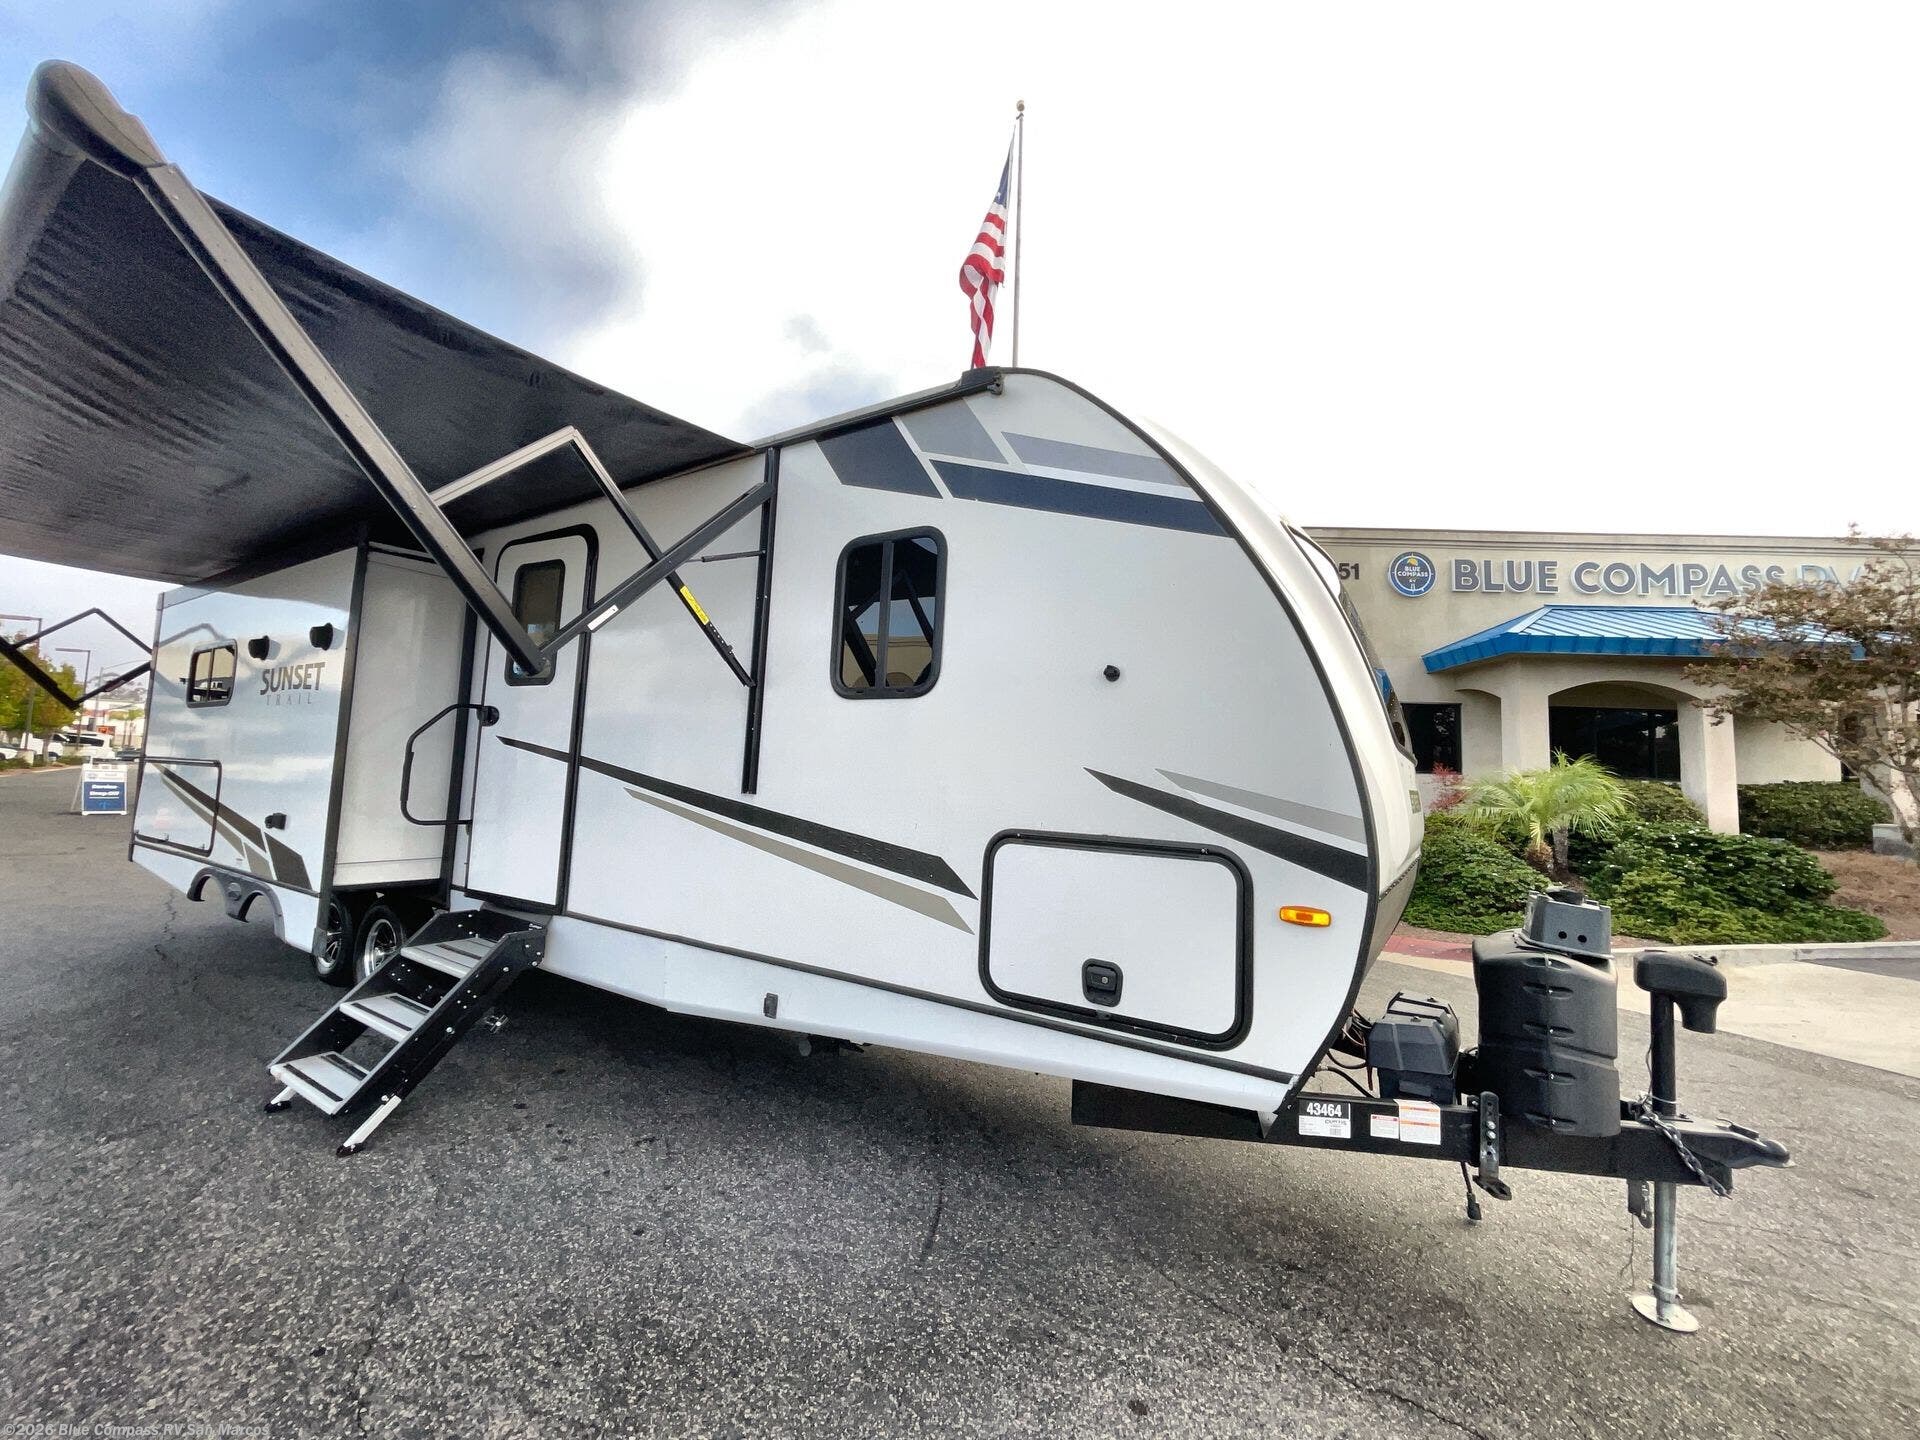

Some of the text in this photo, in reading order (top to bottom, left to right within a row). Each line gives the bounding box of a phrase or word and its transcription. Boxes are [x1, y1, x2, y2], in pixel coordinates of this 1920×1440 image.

[1451, 559, 1559, 594] BLUE
[1571, 560, 1786, 598] COMPASS
[260, 662, 326, 695] SUNSET
[266, 692, 312, 706] TRAIL
[1306, 1102, 1343, 1117] 43464
